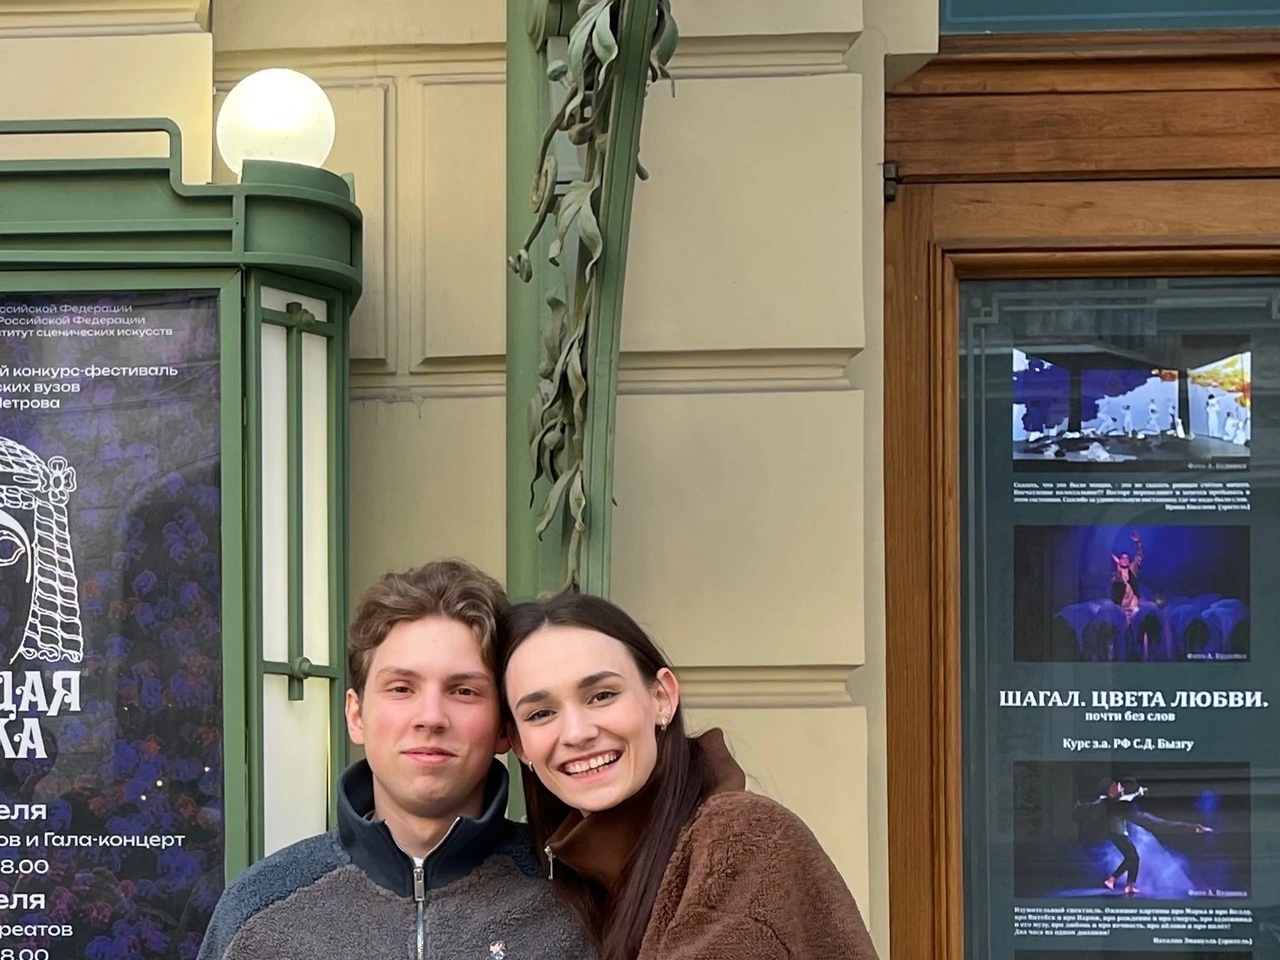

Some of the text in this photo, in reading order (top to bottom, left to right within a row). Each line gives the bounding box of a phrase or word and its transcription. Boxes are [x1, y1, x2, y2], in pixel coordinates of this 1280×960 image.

[60, 303, 132, 315] Федерации
[73, 315, 145, 327] Федерации
[37, 327, 114, 339] сценических
[117, 327, 173, 337] искусств
[13, 365, 178, 379] конкурс-фестиваль
[34, 382, 80, 392] вузов
[1000, 691, 1268, 710] ШАГАЛ. ЦВЕТА ЛЮБВИ.
[1086, 711, 1175, 721] почти без слов
[1063, 738, 1194, 751] Курс з.а. РФ С.Д. Бызгу
[26, 835, 38, 847] и
[44, 832, 185, 849] Гала-концерт
